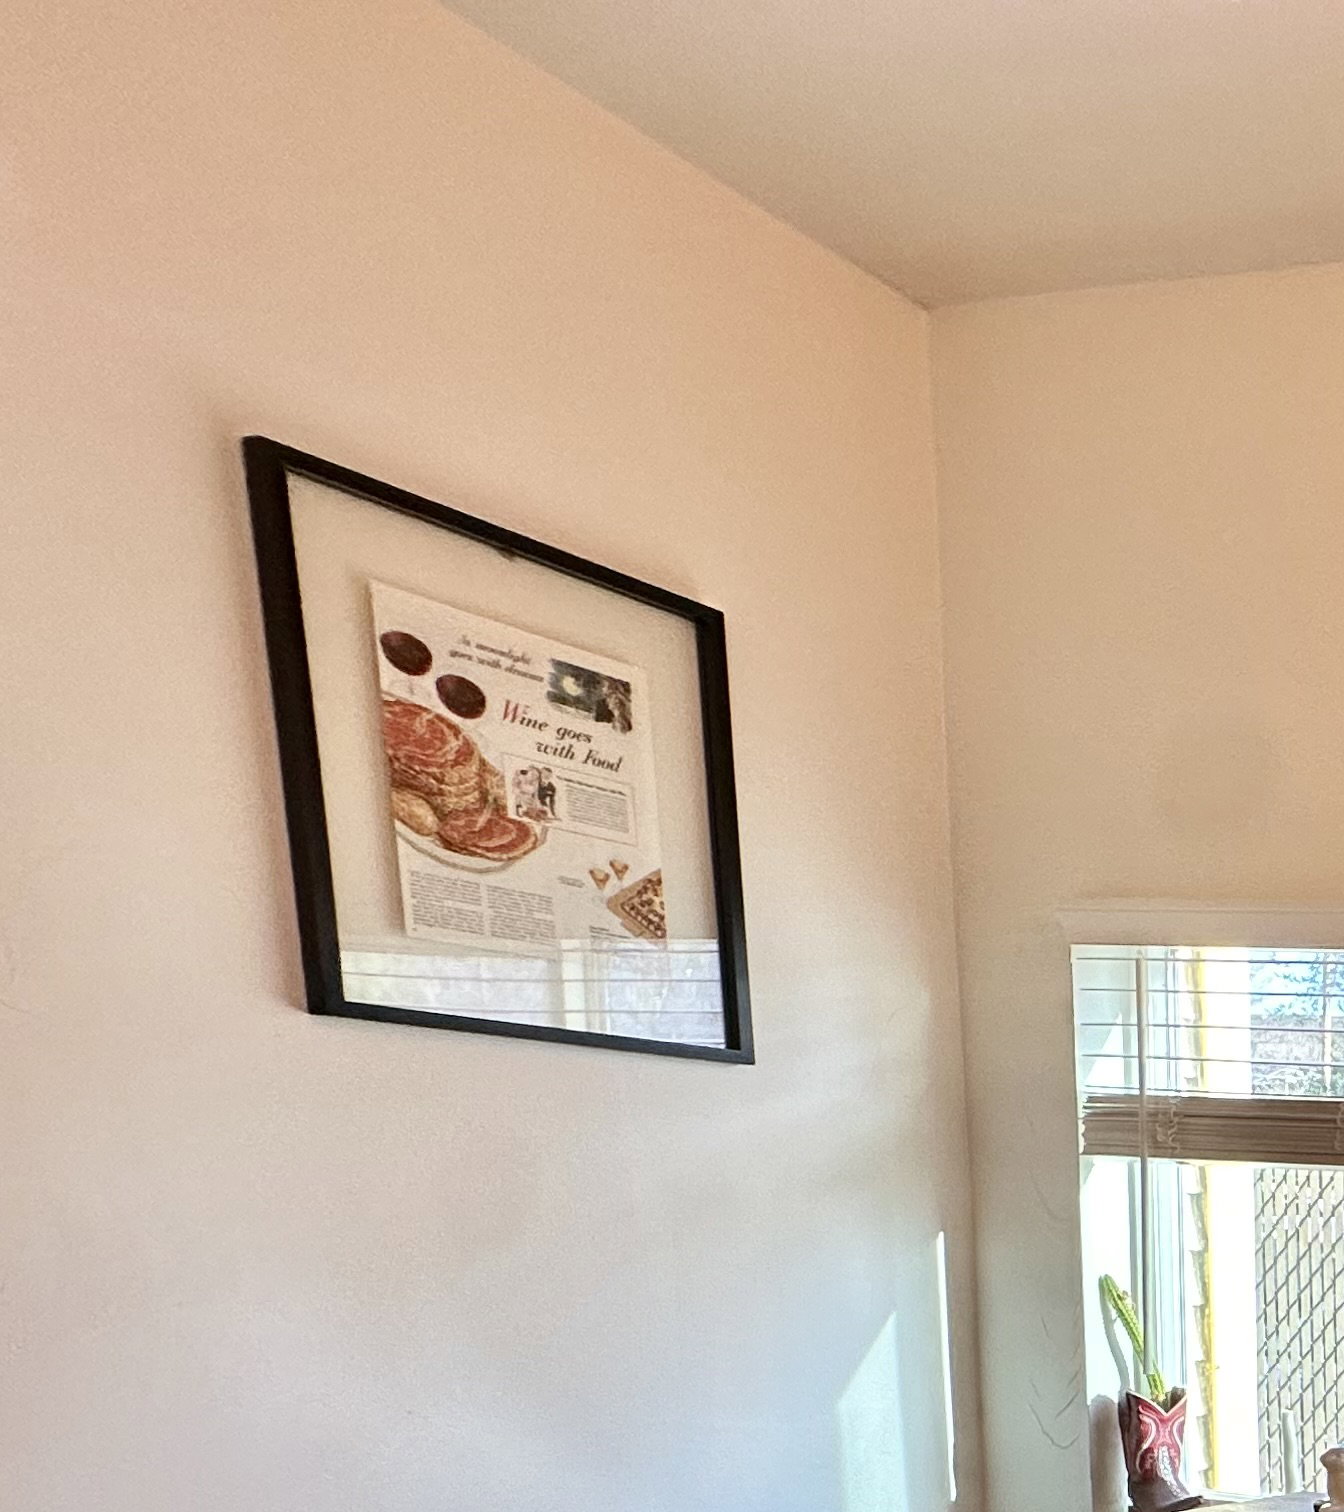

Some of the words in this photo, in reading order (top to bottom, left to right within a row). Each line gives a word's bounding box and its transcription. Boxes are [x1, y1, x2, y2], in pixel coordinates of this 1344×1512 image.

[502, 699, 549, 732] Wine
[556, 725, 593, 744] goes
[535, 741, 575, 761] with
[582, 749, 623, 773] Food
